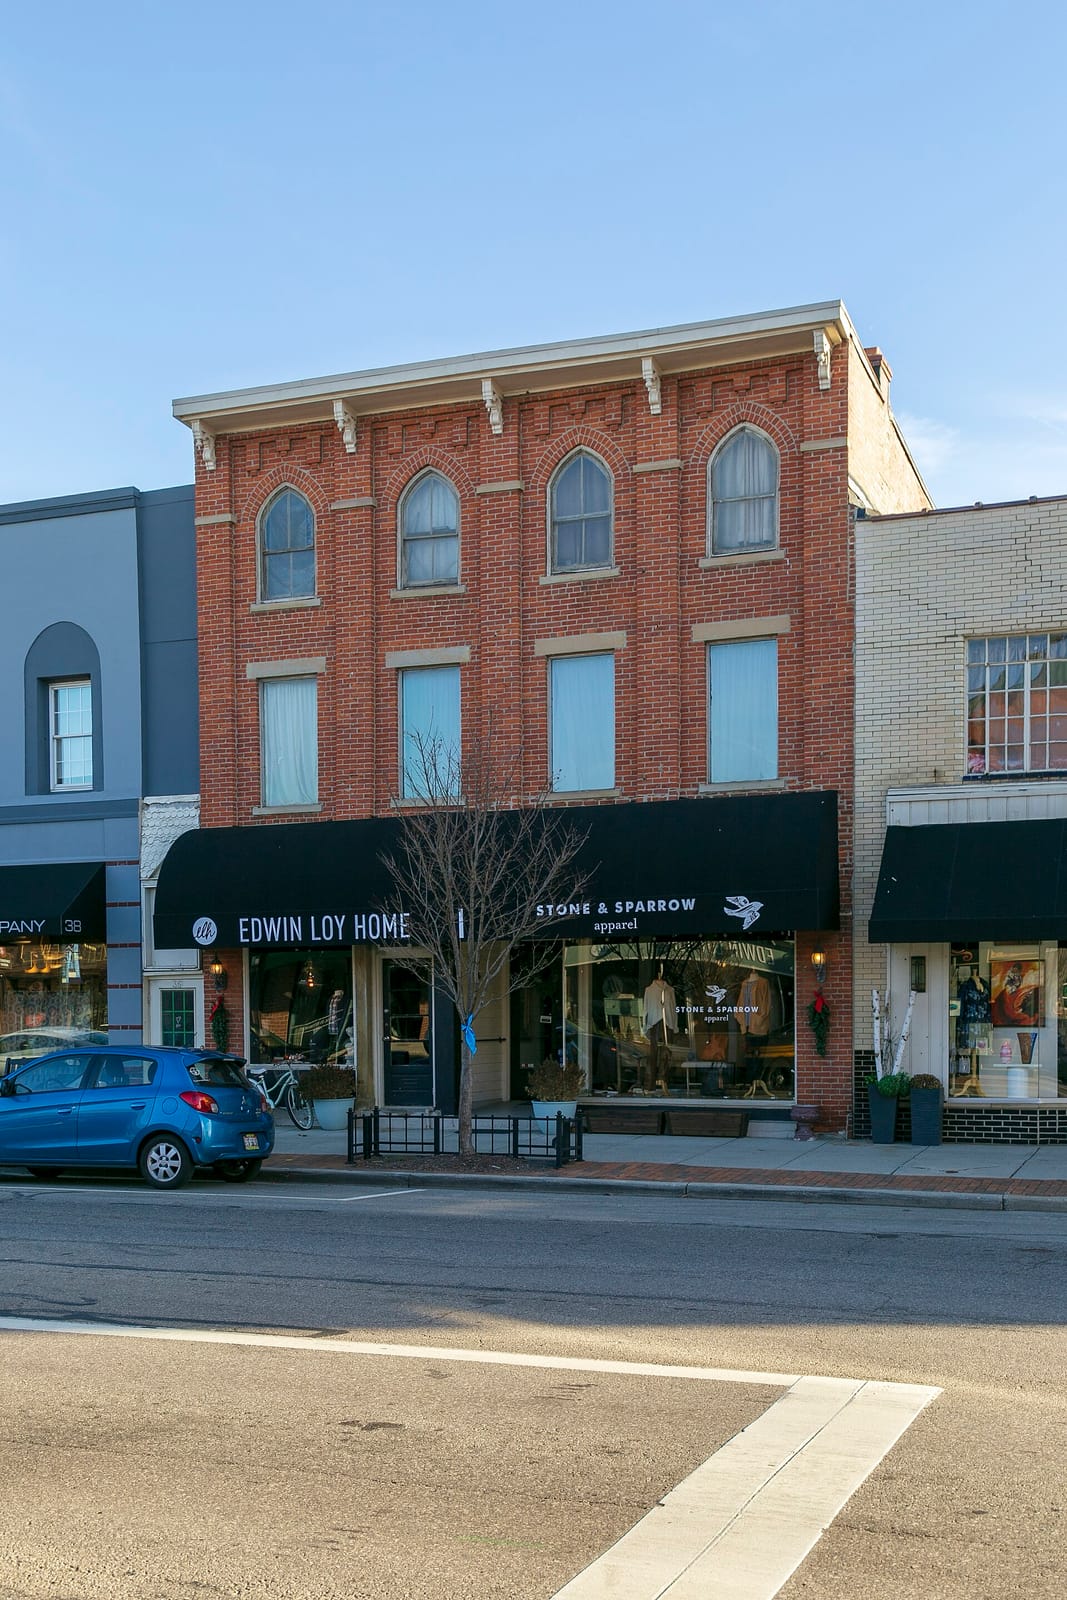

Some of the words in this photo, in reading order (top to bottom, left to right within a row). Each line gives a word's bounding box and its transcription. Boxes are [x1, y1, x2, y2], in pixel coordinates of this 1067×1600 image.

[536, 903, 591, 916] STONE
[597, 902, 609, 914] &
[614, 898, 696, 913] SPARROW
[0, 919, 46, 933] PANY
[64, 919, 82, 933] 38
[239, 916, 302, 942] EDWIN
[311, 915, 346, 941] LOY
[354, 912, 410, 940] HOME
[594, 917, 638, 934] apparel
[704, 1014, 729, 1023] apparel
